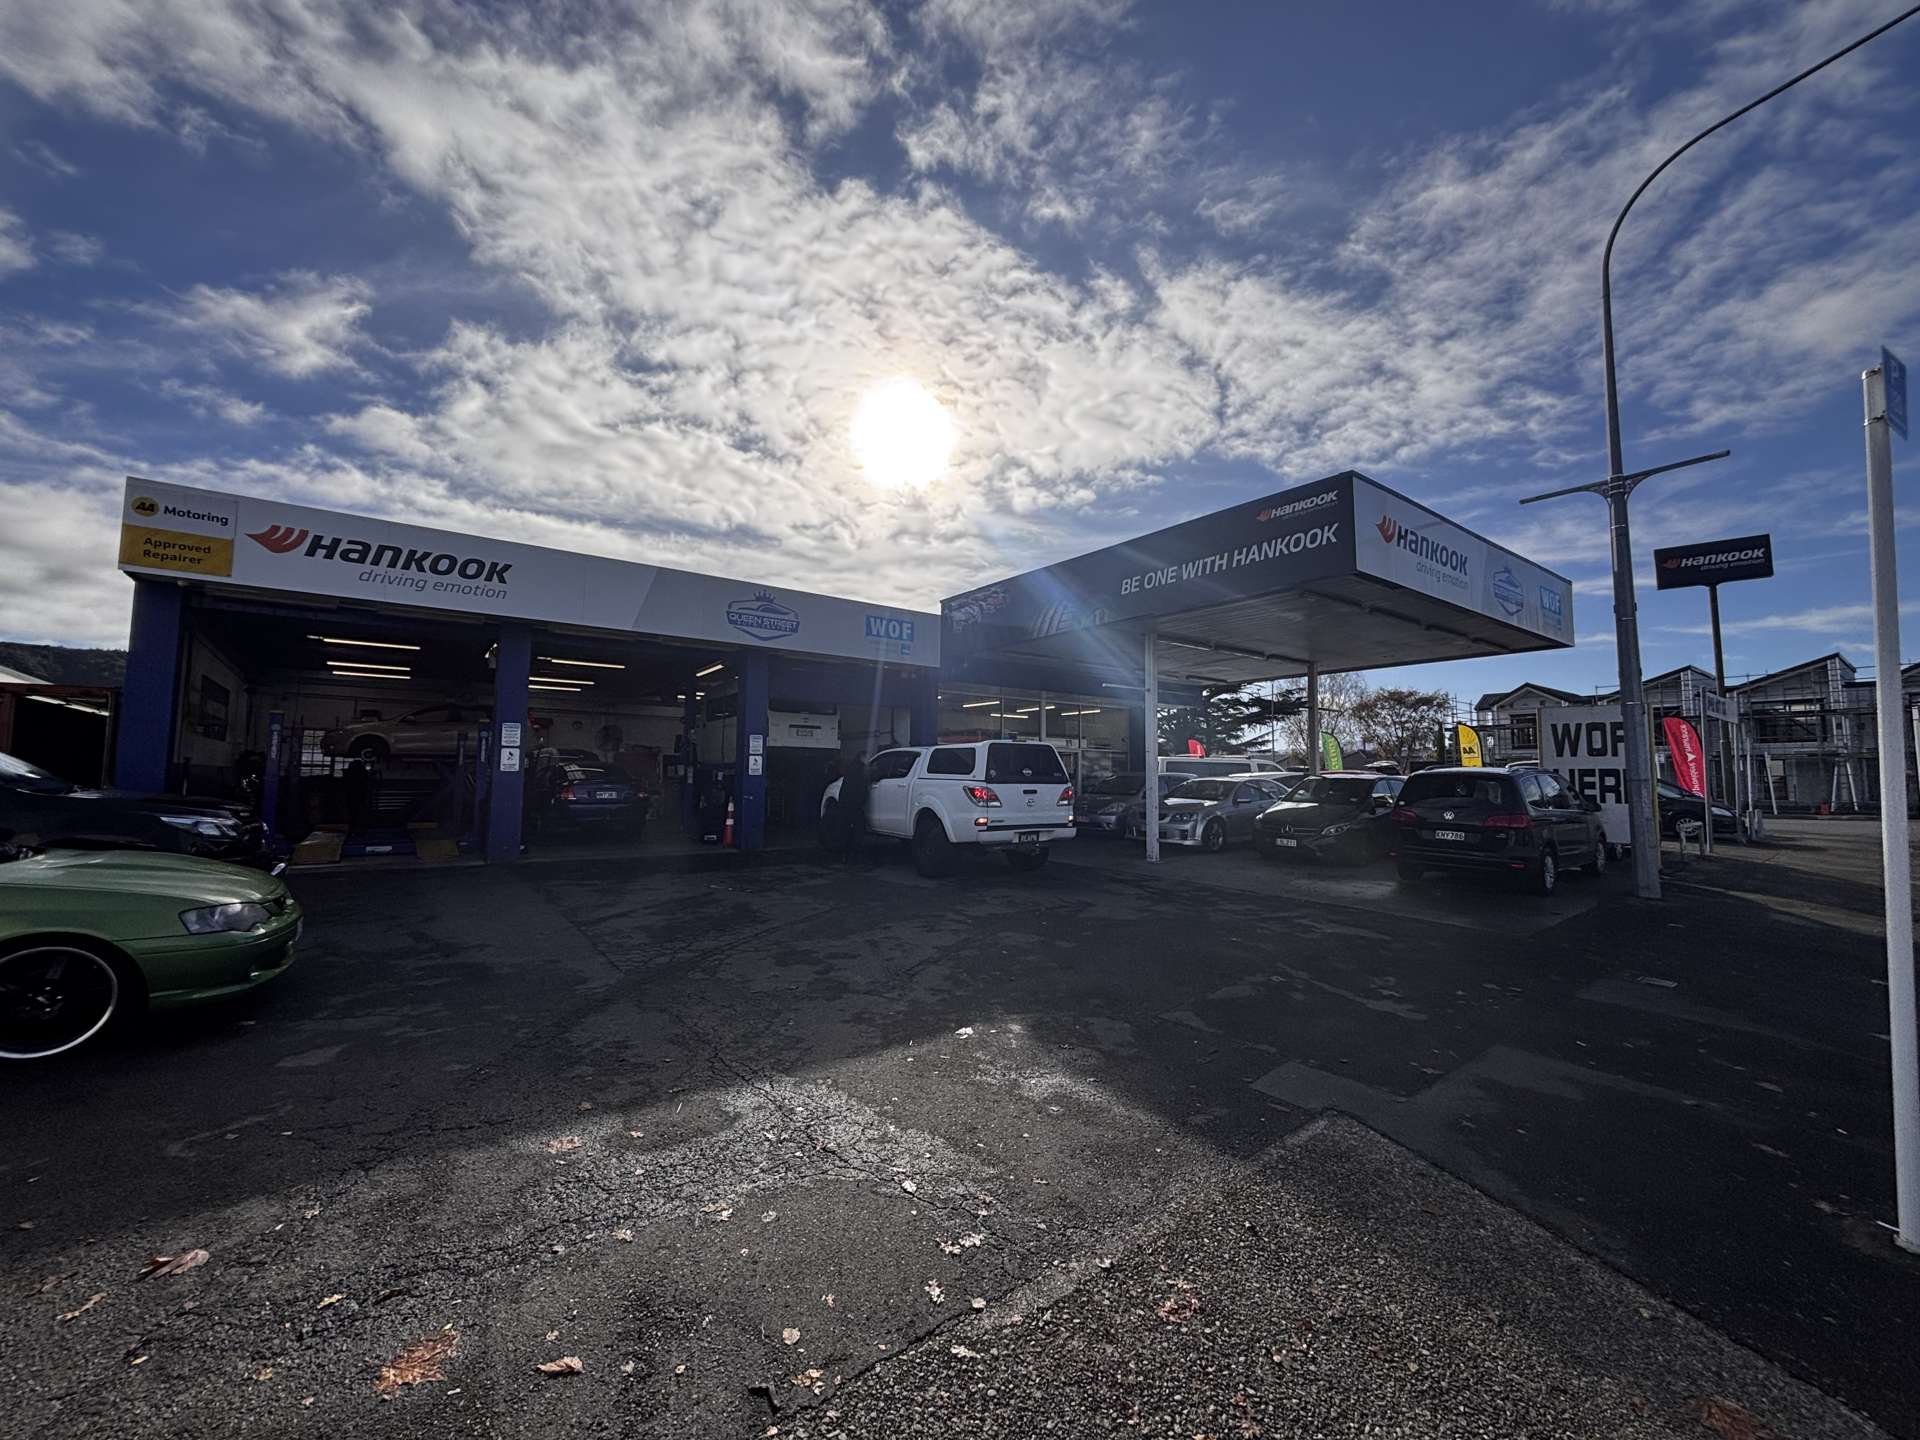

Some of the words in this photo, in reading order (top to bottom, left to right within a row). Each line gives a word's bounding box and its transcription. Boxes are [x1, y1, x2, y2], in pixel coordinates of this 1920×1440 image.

[135, 501, 156, 513] AA
[163, 504, 229, 527] Motoring
[142, 549, 204, 566] Repairer
[143, 536, 212, 556] Approved
[1121, 575, 1141, 595] BE
[1144, 566, 1178, 590] ONE
[1182, 552, 1227, 581] WITH
[1231, 523, 1339, 567] HANKOOK
[358, 568, 429, 592] driving
[432, 580, 508, 600] emotion
[729, 613, 762, 625] QUEEN
[763, 618, 797, 629] STREET
[869, 616, 912, 640] WOF
